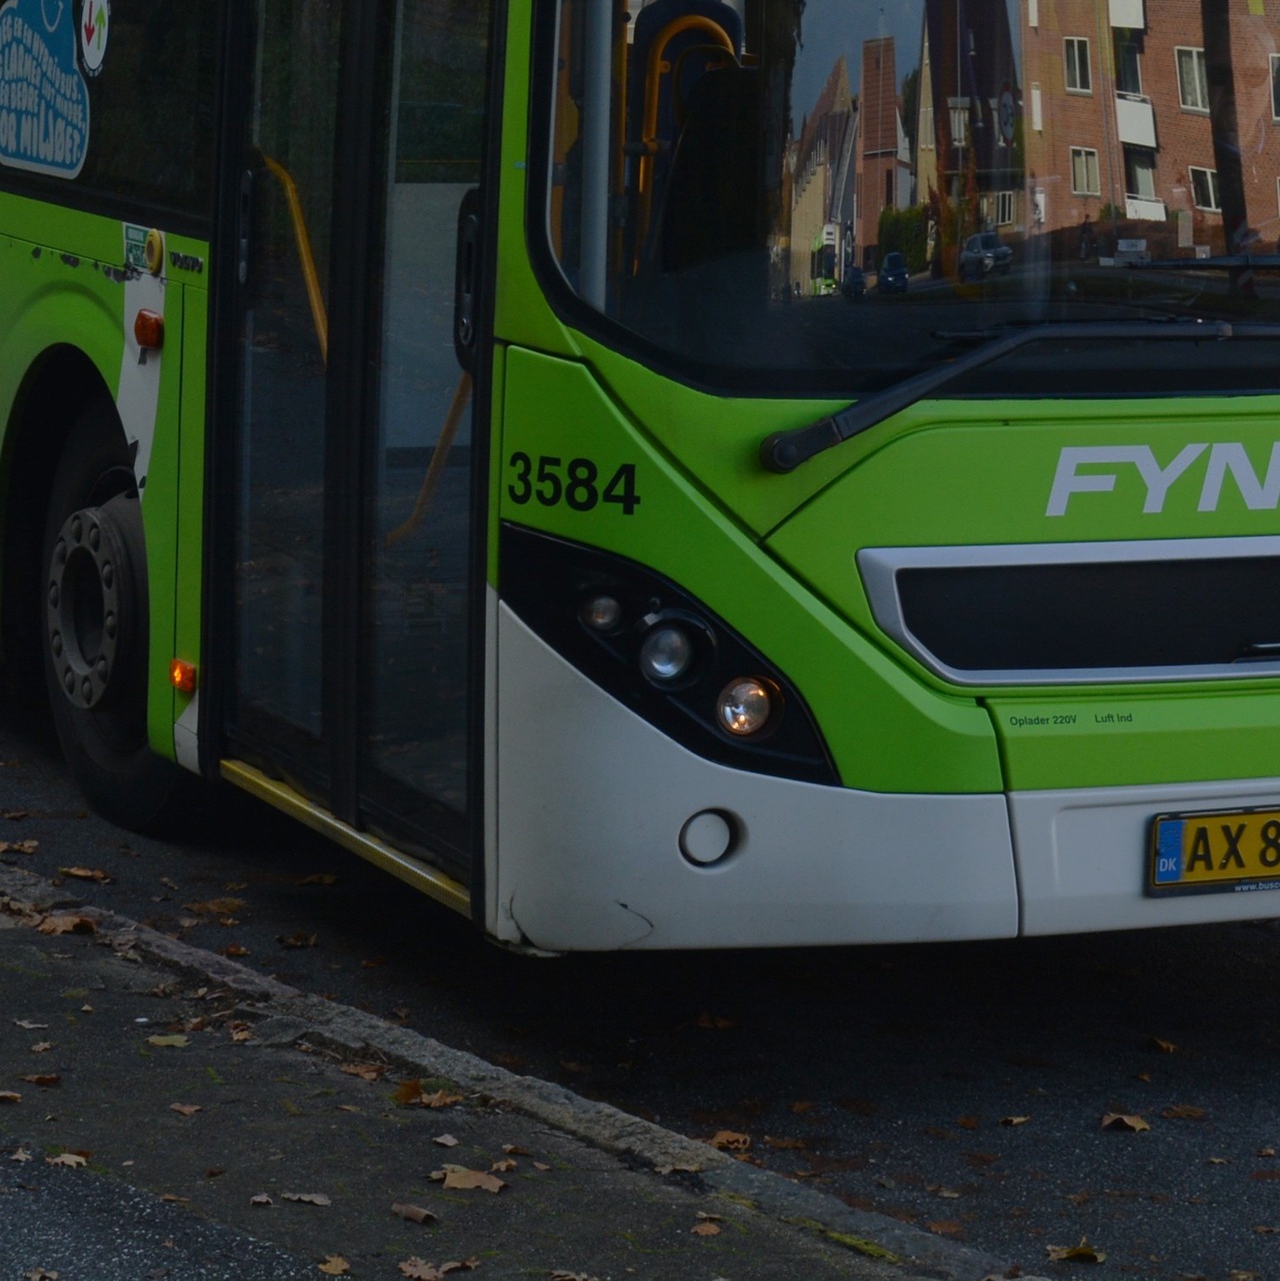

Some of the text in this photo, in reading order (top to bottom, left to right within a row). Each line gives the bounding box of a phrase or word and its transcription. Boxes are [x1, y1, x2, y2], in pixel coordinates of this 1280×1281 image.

[507, 451, 641, 516] 3584
[1009, 714, 1077, 728] Oplader 220V
[1094, 713, 1133, 724] Luft Ind
[1186, 822, 1246, 872] AX
[1159, 857, 1177, 872] DK
